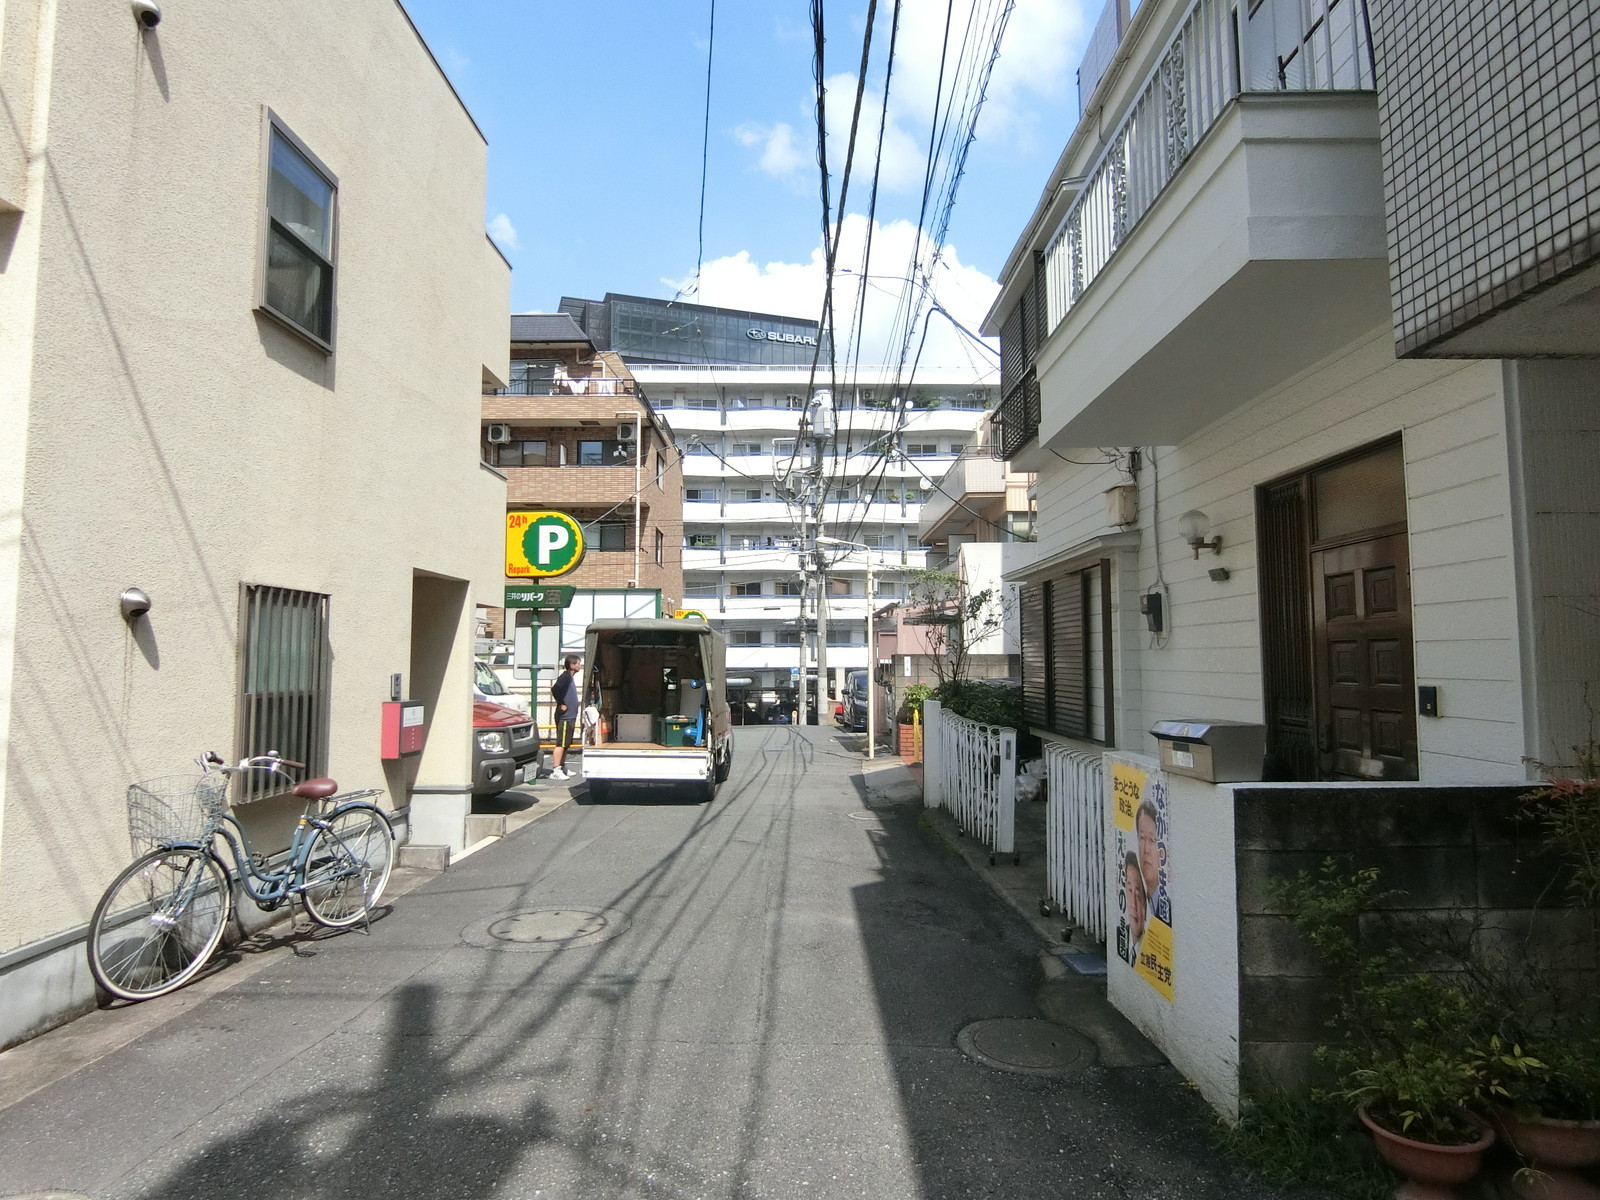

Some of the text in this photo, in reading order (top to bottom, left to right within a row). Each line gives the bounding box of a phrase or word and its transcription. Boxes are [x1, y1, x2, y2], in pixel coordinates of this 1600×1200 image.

[509, 515, 528, 528] 24h
[538, 525, 569, 565] P
[508, 563, 531, 575] Repark
[506, 591, 544, 602] 三井のリパーク
[1113, 776, 1140, 800] まっとうな
